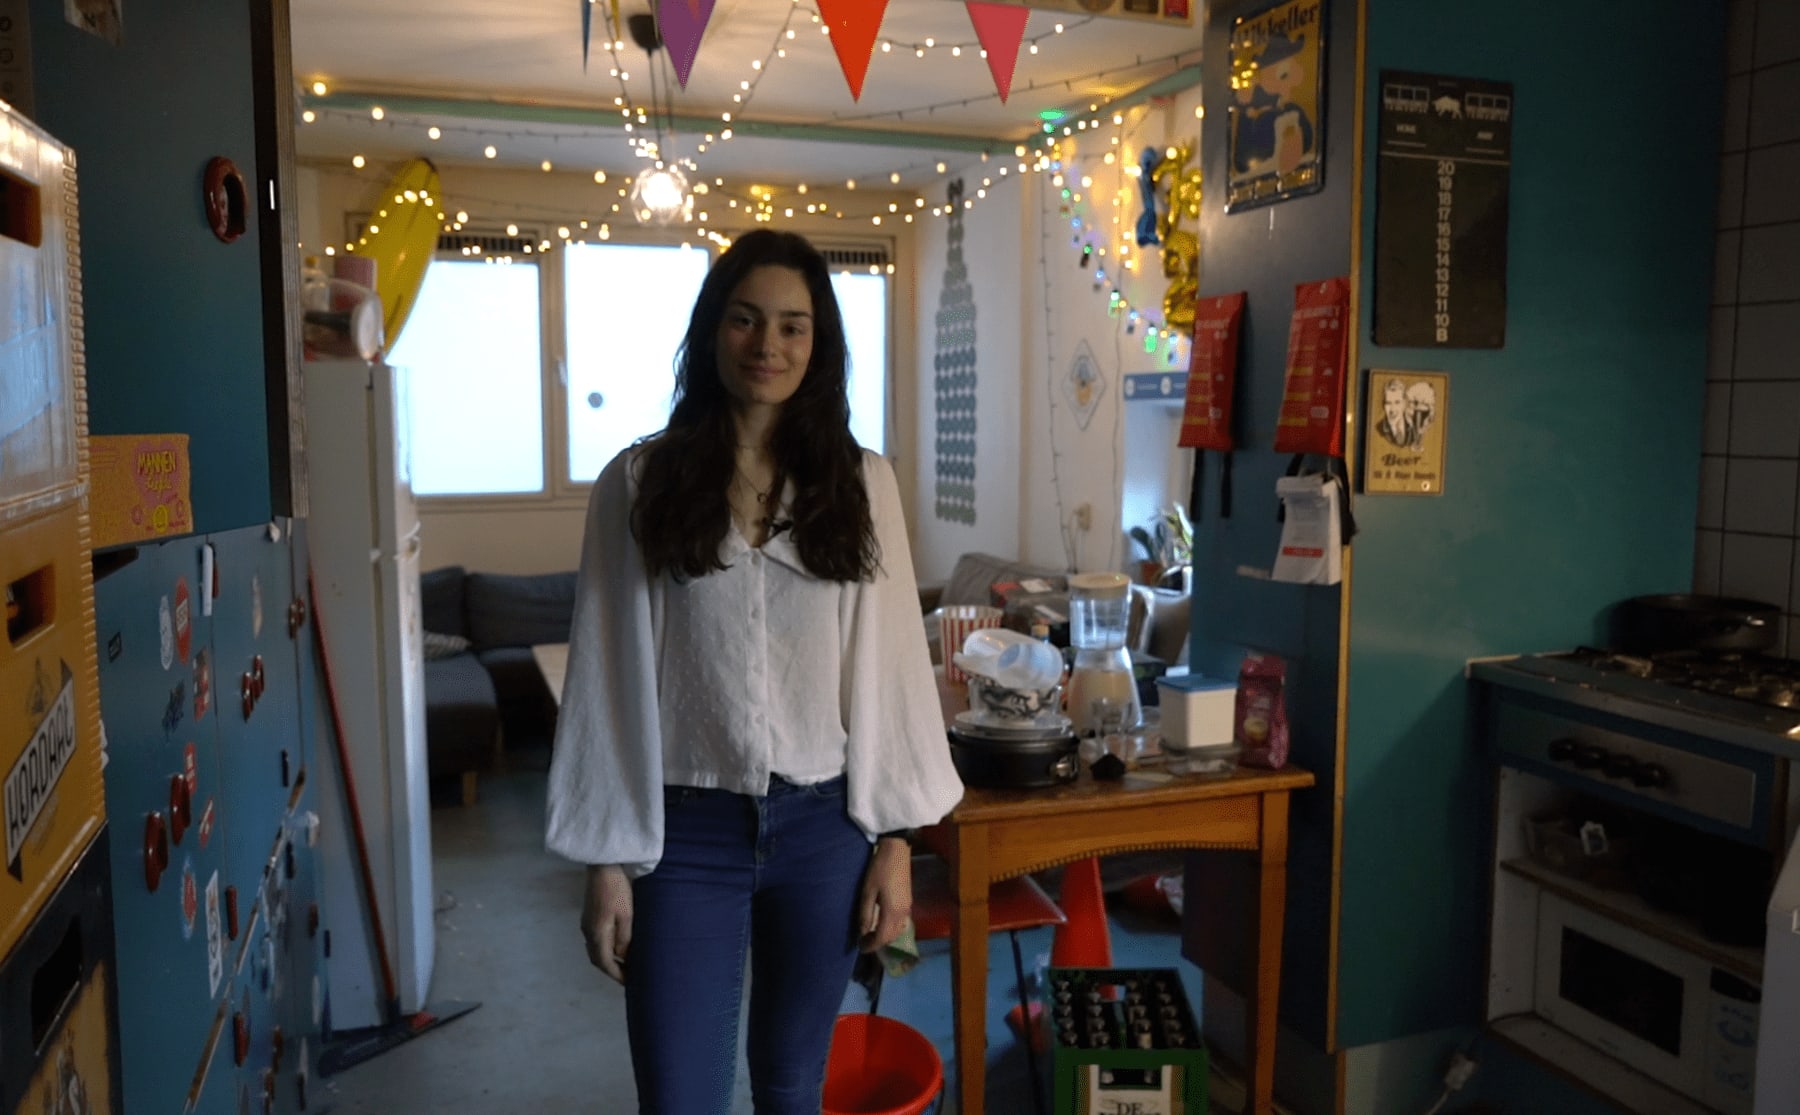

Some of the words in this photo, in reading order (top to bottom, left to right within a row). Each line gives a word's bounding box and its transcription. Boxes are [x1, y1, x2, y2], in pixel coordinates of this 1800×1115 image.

[1437, 160, 1455, 175] 20
[1438, 176, 1452, 190] 19
[1437, 191, 1452, 206] 18
[1437, 207, 1451, 221] 17
[1436, 237, 1450, 251] 15
[1436, 252, 1450, 267] 14
[1435, 267, 1449, 281] 13
[1435, 282, 1449, 297] 12
[1435, 298, 1448, 312] 11
[1434, 313, 1450, 327] 10
